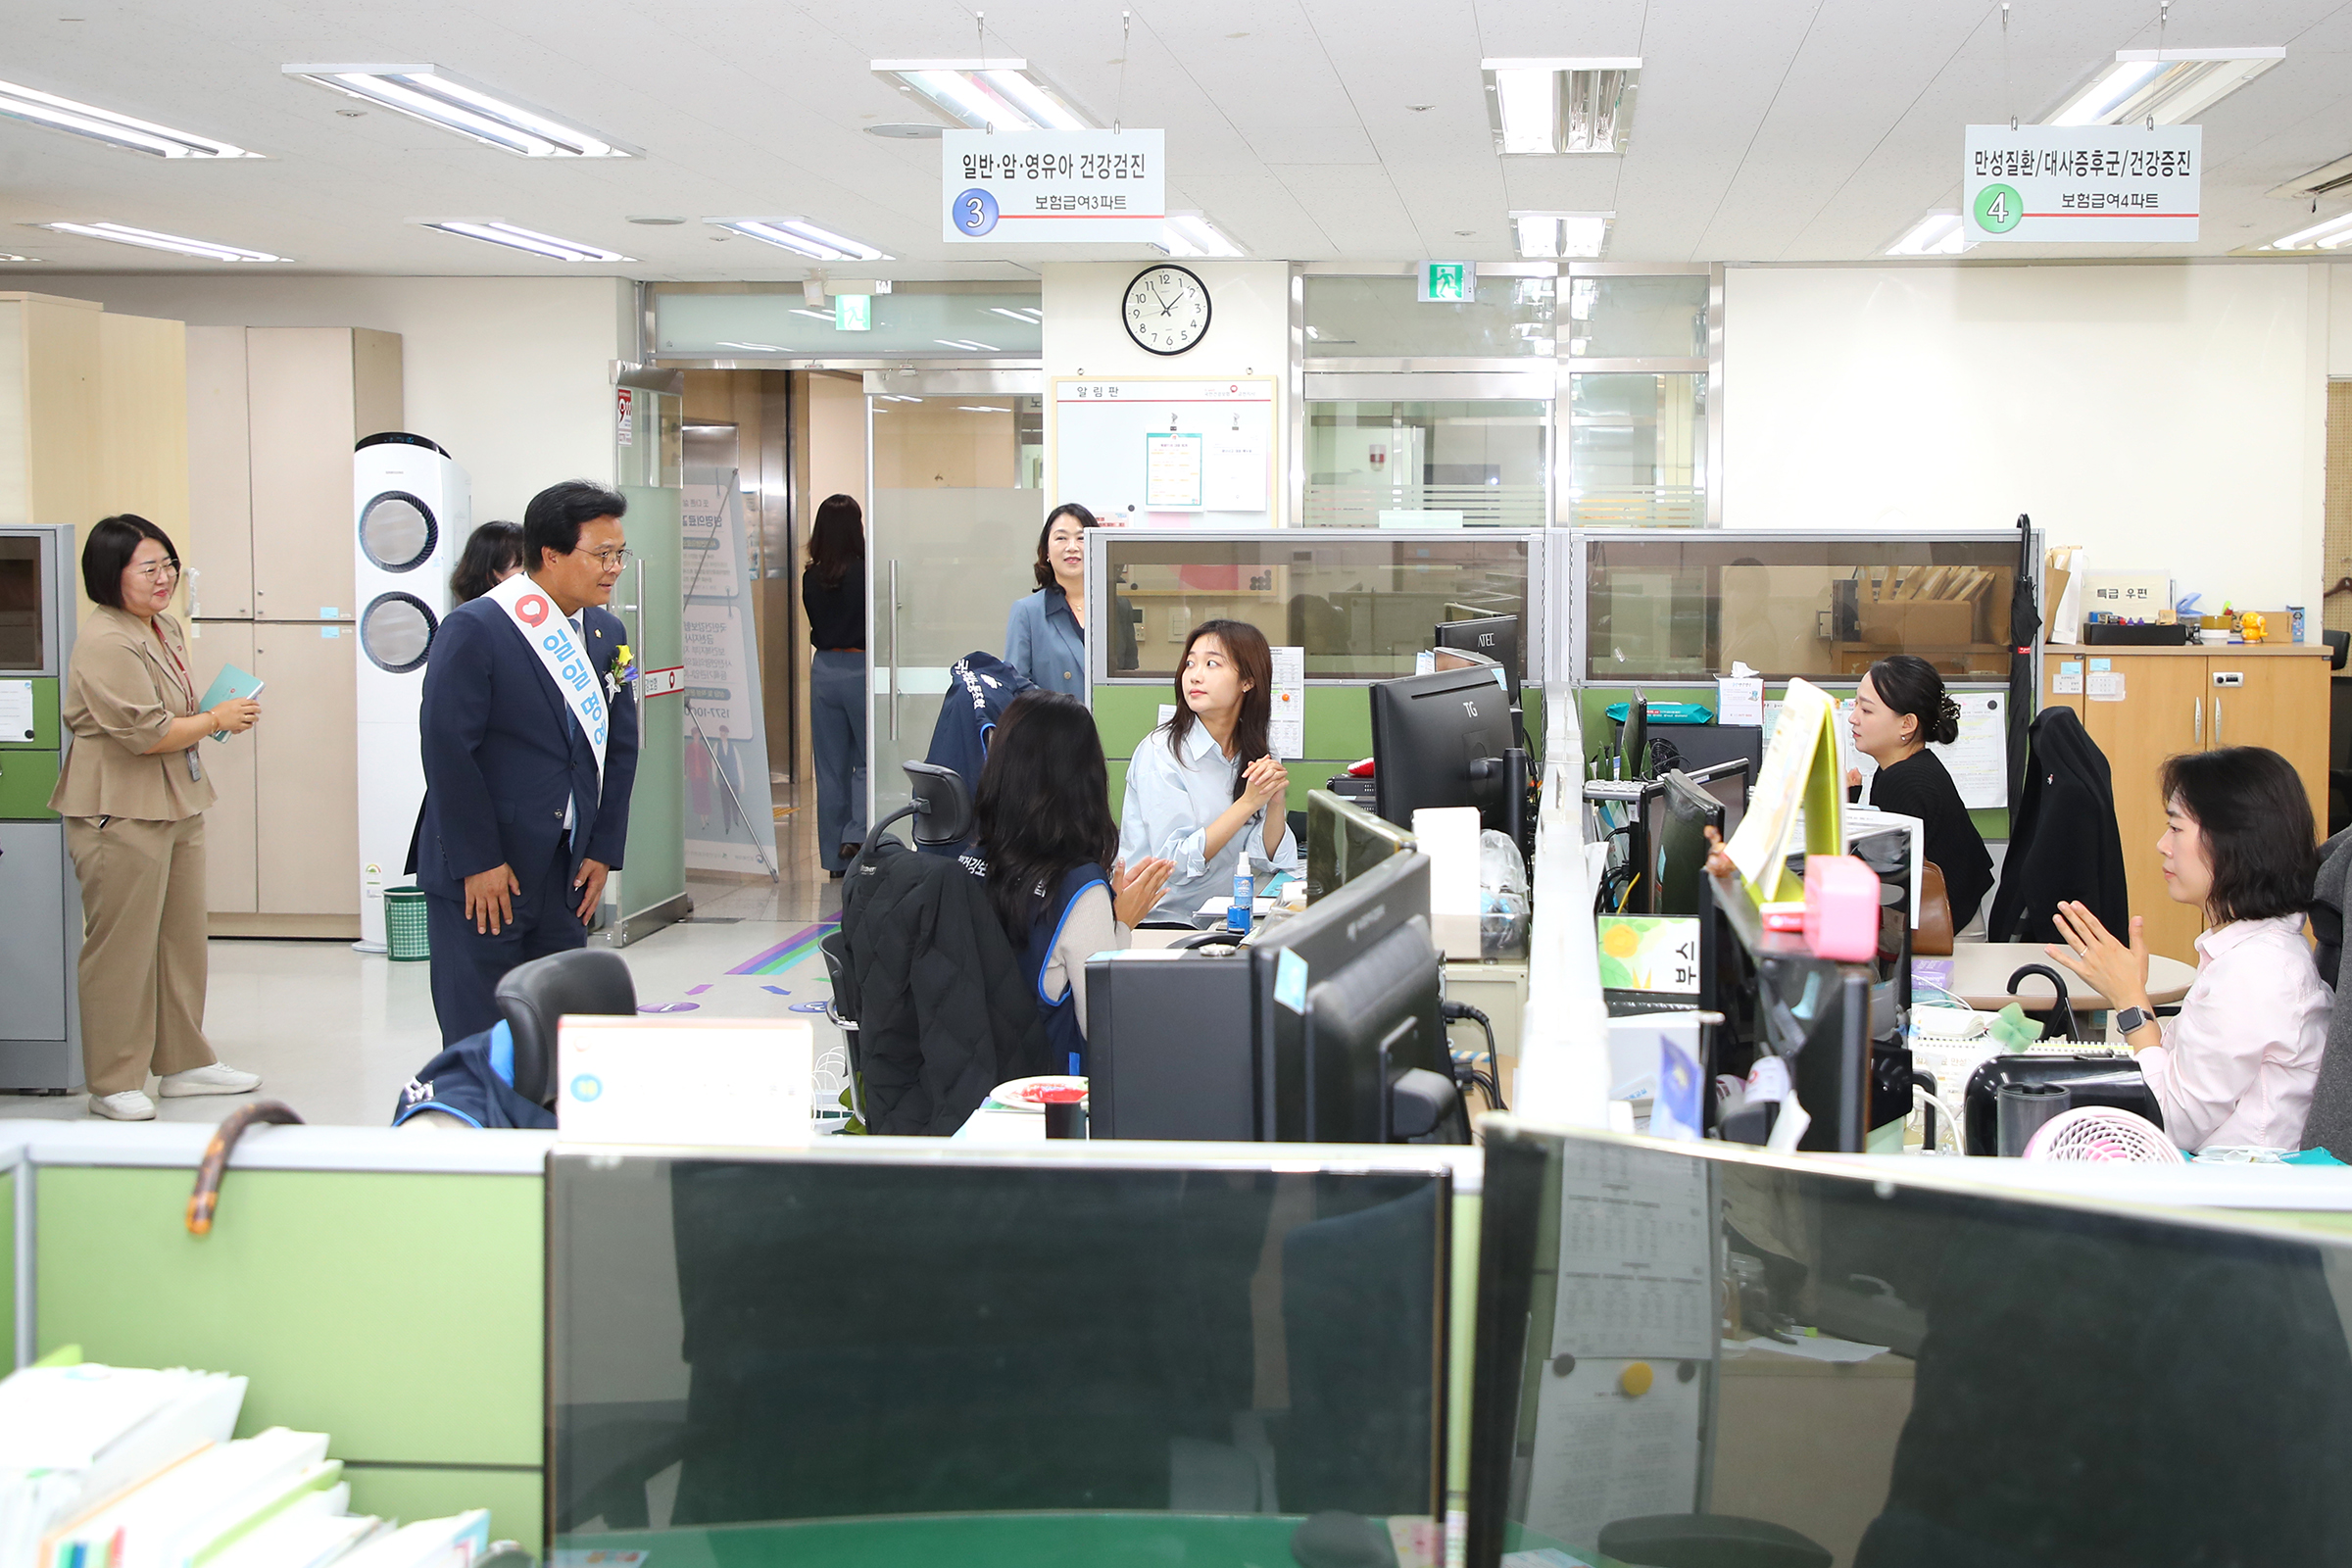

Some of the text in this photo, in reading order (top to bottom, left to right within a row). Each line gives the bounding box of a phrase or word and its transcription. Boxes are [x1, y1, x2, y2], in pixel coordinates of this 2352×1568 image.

[961, 153, 1146, 179] 일반·암·영유아 건강검진
[1974, 149, 2191, 177] 만성질환/대사증후군/건강증진
[1035, 194, 1127, 210] 보험급여3파트
[2061, 192, 2159, 209] 보험급여4파트
[965, 197, 985, 228] 3
[1986, 191, 2009, 223] 4
[1158, 273, 1171, 285] 12
[1178, 277, 1183, 288] 1
[1145, 280, 1154, 291] 11
[1136, 293, 1147, 304] 10
[1133, 309, 1141, 319] 9
[1195, 303, 1201, 314] 3
[1139, 322, 1147, 334] 8
[1190, 318, 1198, 328] 4
[1151, 332, 1158, 343] 7
[1165, 335, 1174, 346] 6
[1181, 329, 1188, 341] 5
[2096, 588, 2148, 600] 특급 우편
[1477, 632, 1495, 647] ATEC
[1462, 701, 1479, 717] TG
